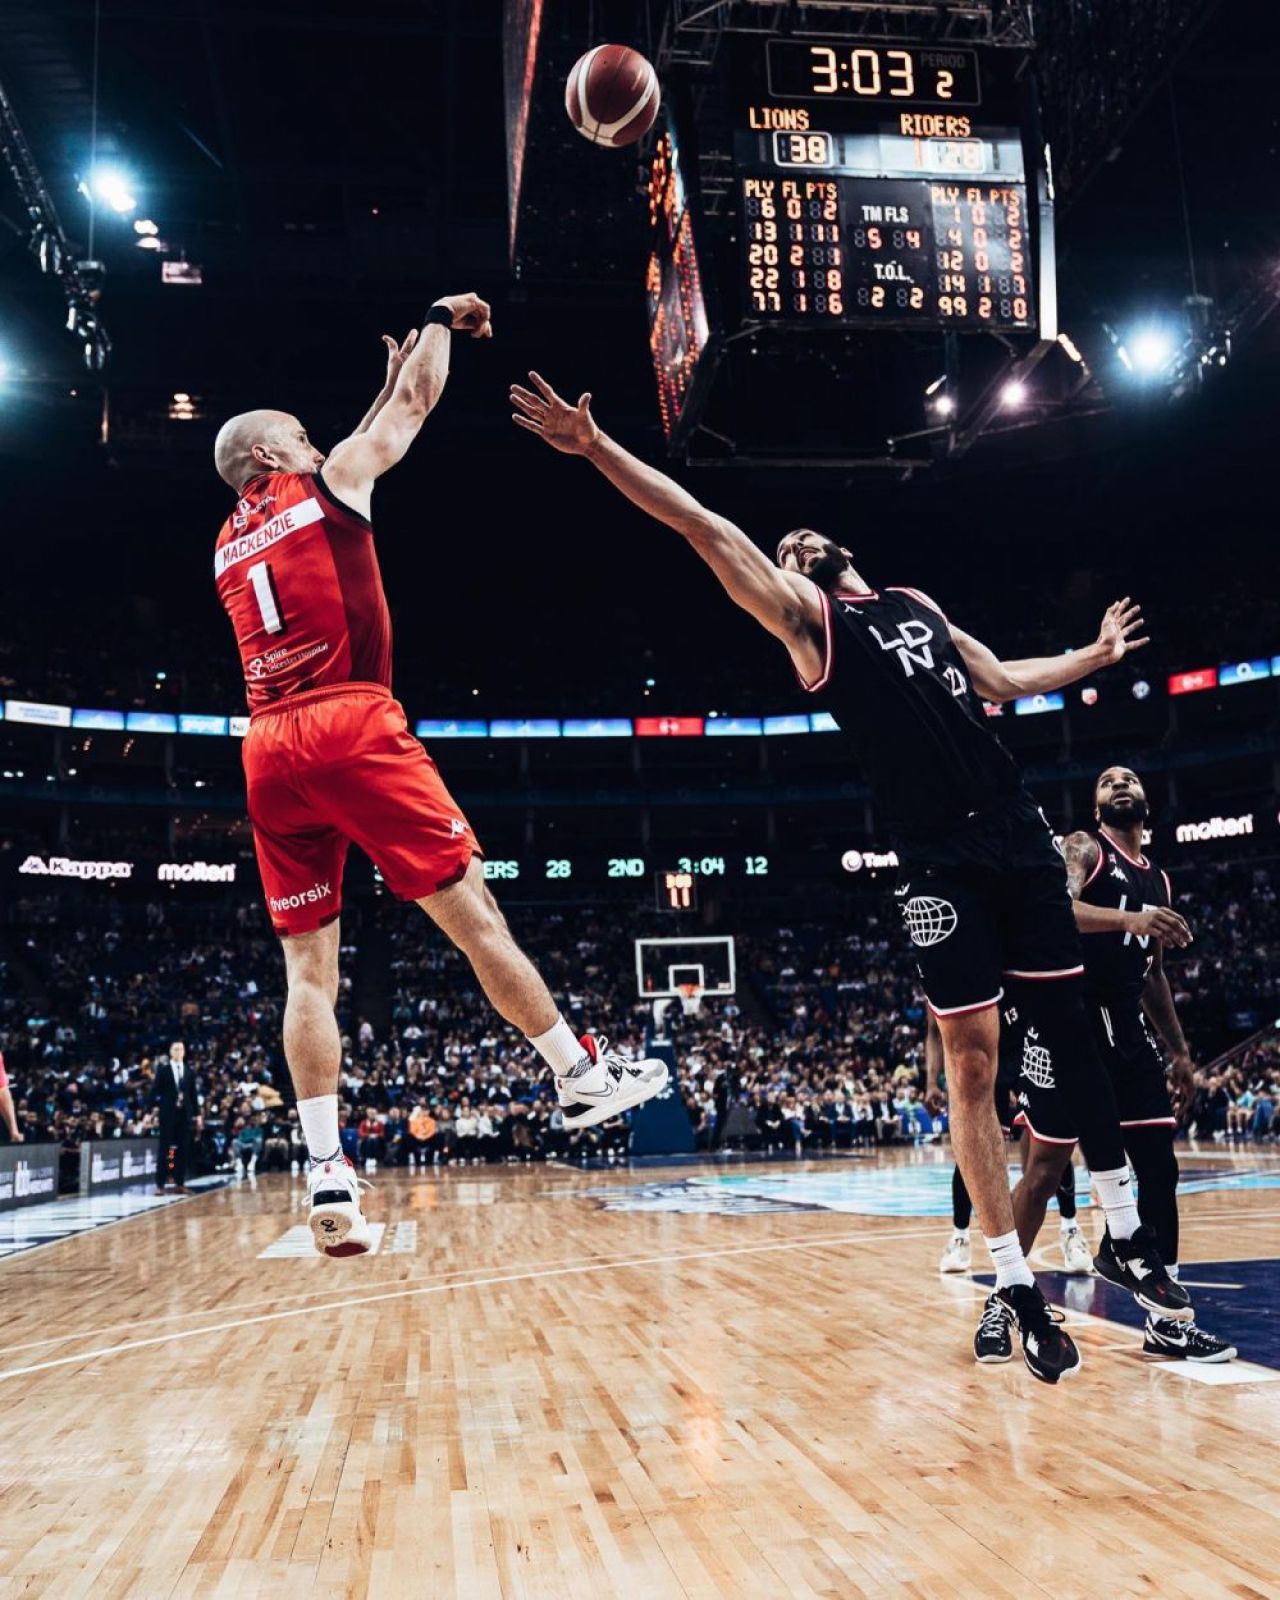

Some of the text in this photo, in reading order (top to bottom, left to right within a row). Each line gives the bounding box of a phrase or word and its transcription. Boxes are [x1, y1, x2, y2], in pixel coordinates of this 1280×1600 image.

[811, 47, 914, 96] 3:03
[921, 53, 965, 68] PERIOD
[937, 70, 953, 98] 2
[749, 107, 810, 131] LIONS
[901, 113, 972, 137] RIDERS
[790, 135, 827, 163] 38
[744, 179, 838, 200] PLY FL PTS
[931, 186, 1020, 206] PLY FL PTS
[761, 198, 837, 220] 6 0 2
[861, 206, 909, 222] TM FLS
[1007, 206, 1020, 227] 2
[755, 222, 777, 242] 13
[818, 224, 839, 242] 11
[868, 228, 920, 248] 5 4
[948, 228, 1022, 249] 4 0 2
[749, 244, 778, 265] 20
[790, 245, 804, 266] 2
[943, 251, 1023, 272] 12 0 2
[750, 267, 779, 289] 22
[828, 269, 842, 290] 8
[945, 274, 965, 292] 14
[753, 291, 780, 312] 77
[828, 293, 843, 314] 6
[872, 286, 924, 308] 2 2
[938, 296, 1028, 319] 99 2 0
[223, 512, 296, 567] MACKENZIE
[247, 560, 283, 635] 1
[264, 648, 288, 663] Spire
[1176, 813, 1254, 843] molten
[49, 857, 133, 879] Kappa
[157, 861, 236, 882] molten
[482, 856, 768, 879] ERS 28 2ND 3:04 12
[1004, 1007, 1018, 1025] 13
